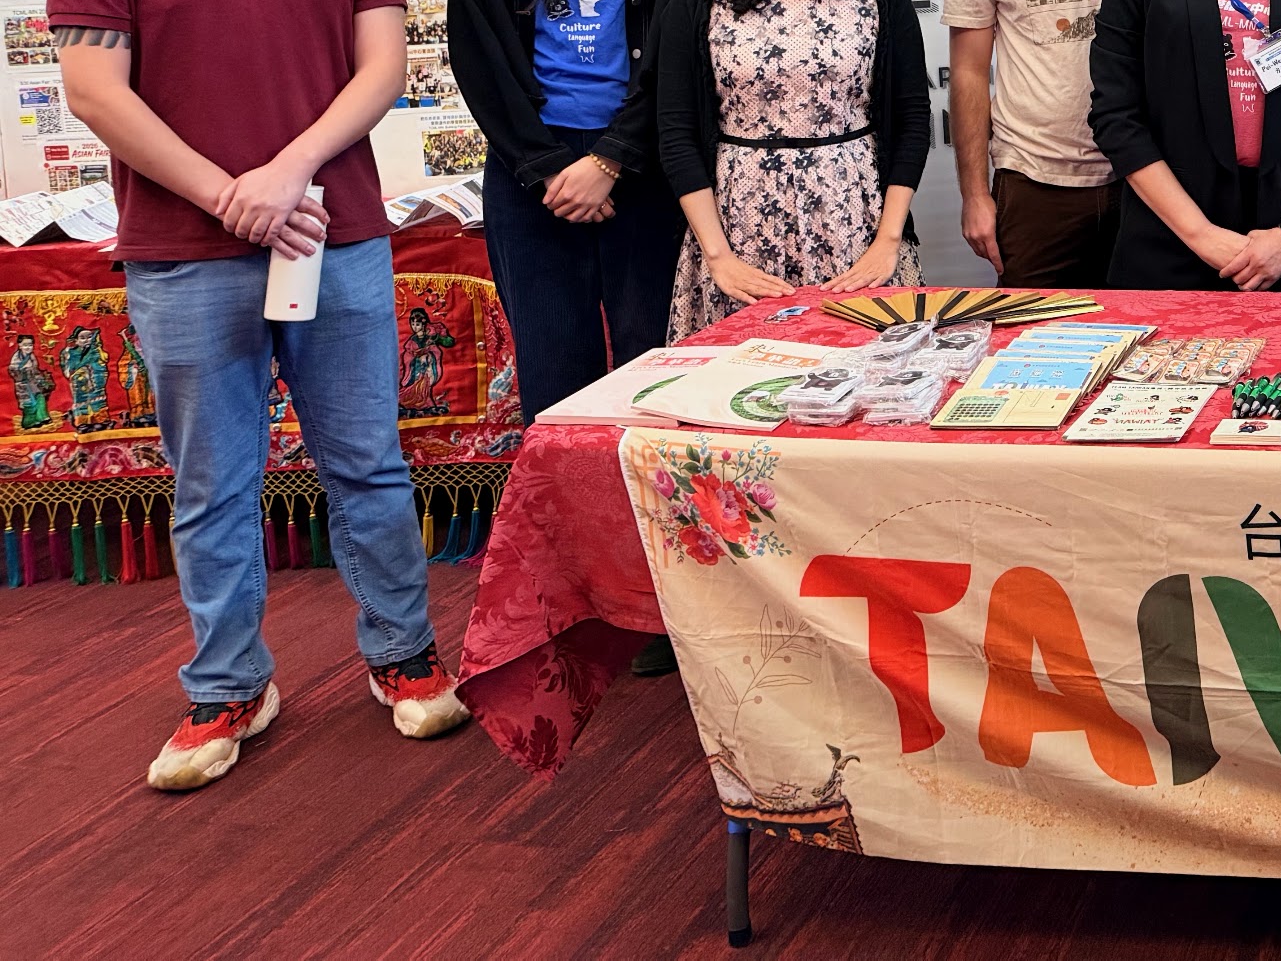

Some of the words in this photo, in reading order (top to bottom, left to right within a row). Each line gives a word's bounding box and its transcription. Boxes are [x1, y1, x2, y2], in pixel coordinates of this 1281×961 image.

[559, 22, 602, 33] Culture
[568, 34, 596, 43] Language
[577, 44, 595, 54] Fun
[1230, 79, 1257, 91] Language
[1240, 92, 1256, 102] Fun
